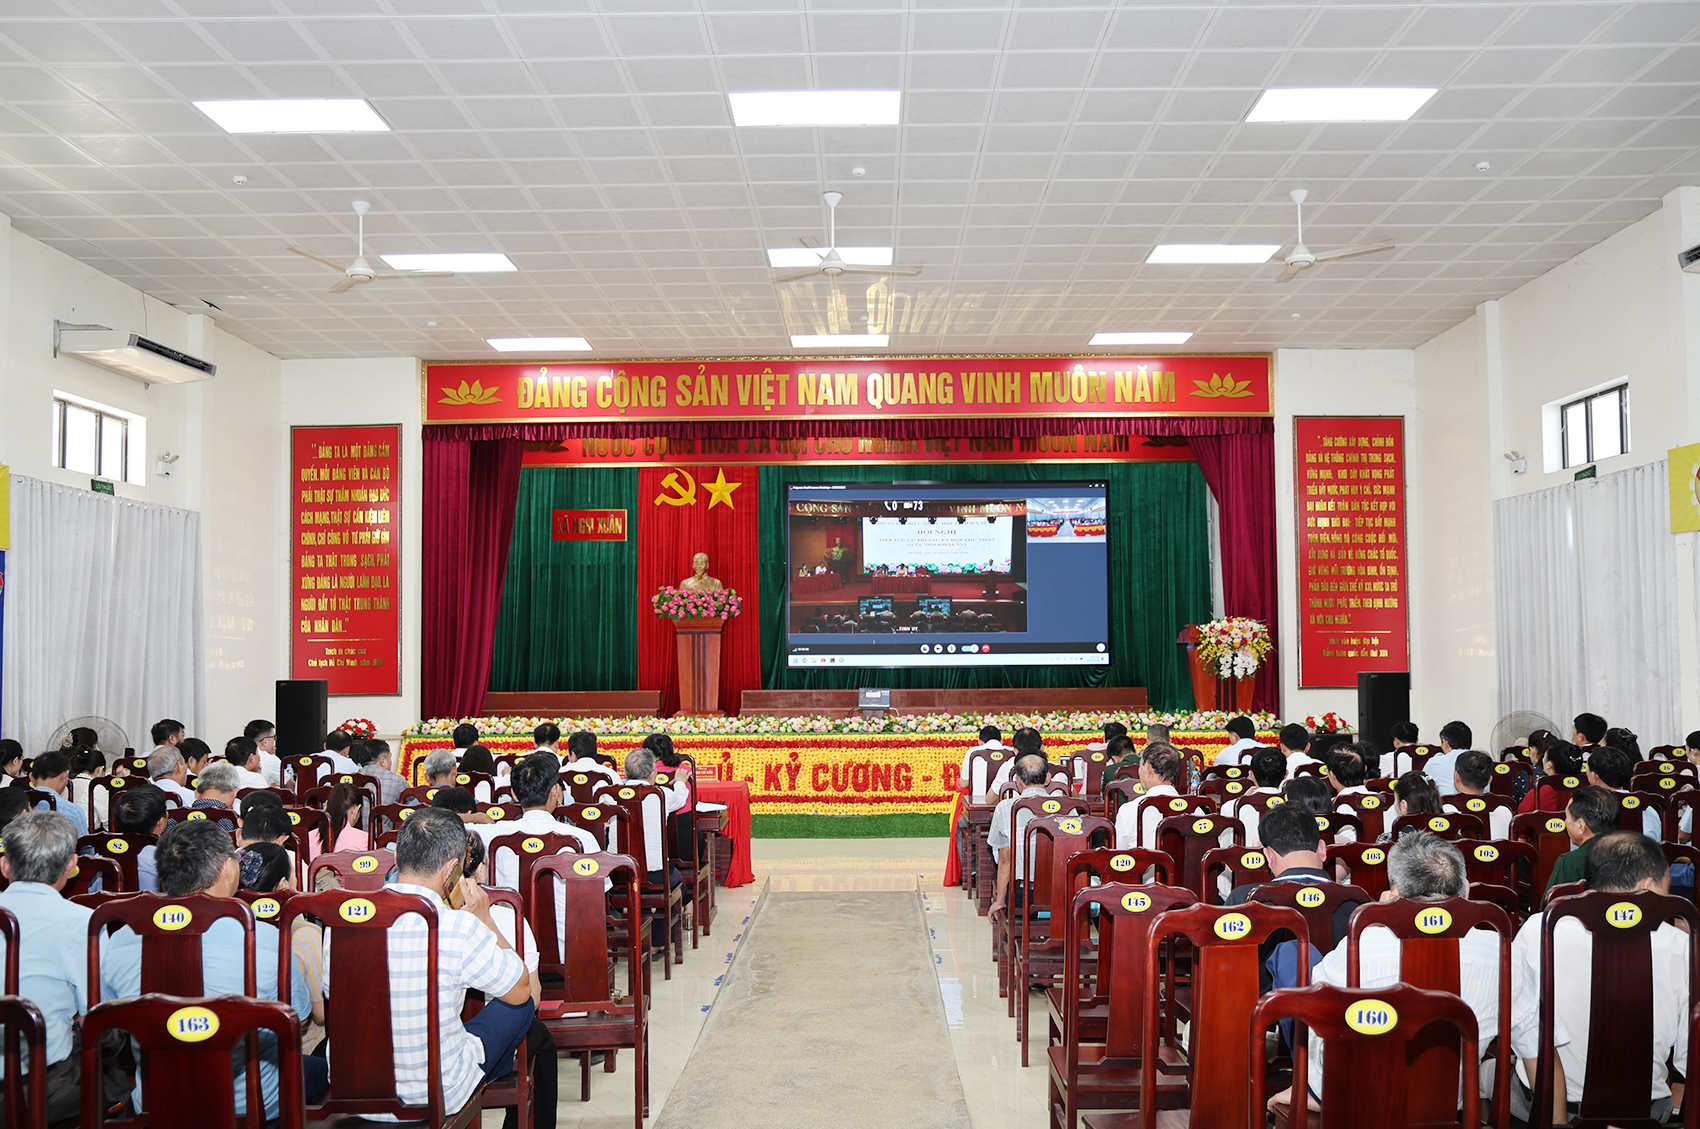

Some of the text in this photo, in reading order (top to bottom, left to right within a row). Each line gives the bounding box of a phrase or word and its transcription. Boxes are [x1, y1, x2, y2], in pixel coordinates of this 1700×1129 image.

[516, 363, 1176, 414] ĐẢNG CỘNG SẢN VIỆT NAM QUANG VINH MUÔN NĂM
[913, 501, 924, 510] 73
[597, 514, 622, 534] XUÂN
[764, 752, 801, 791] KỶ
[812, 760, 912, 792] CƯƠNG
[1128, 898, 1146, 906] 145
[1303, 893, 1320, 902] 146
[258, 904, 274, 912] 122
[348, 906, 367, 916] 121
[162, 913, 184, 923] 140
[1424, 915, 1443, 926] 161
[1614, 909, 1634, 921] 147
[1223, 920, 1244, 932] 162
[1358, 1010, 1388, 1025] 160
[180, 1017, 209, 1032] 163
